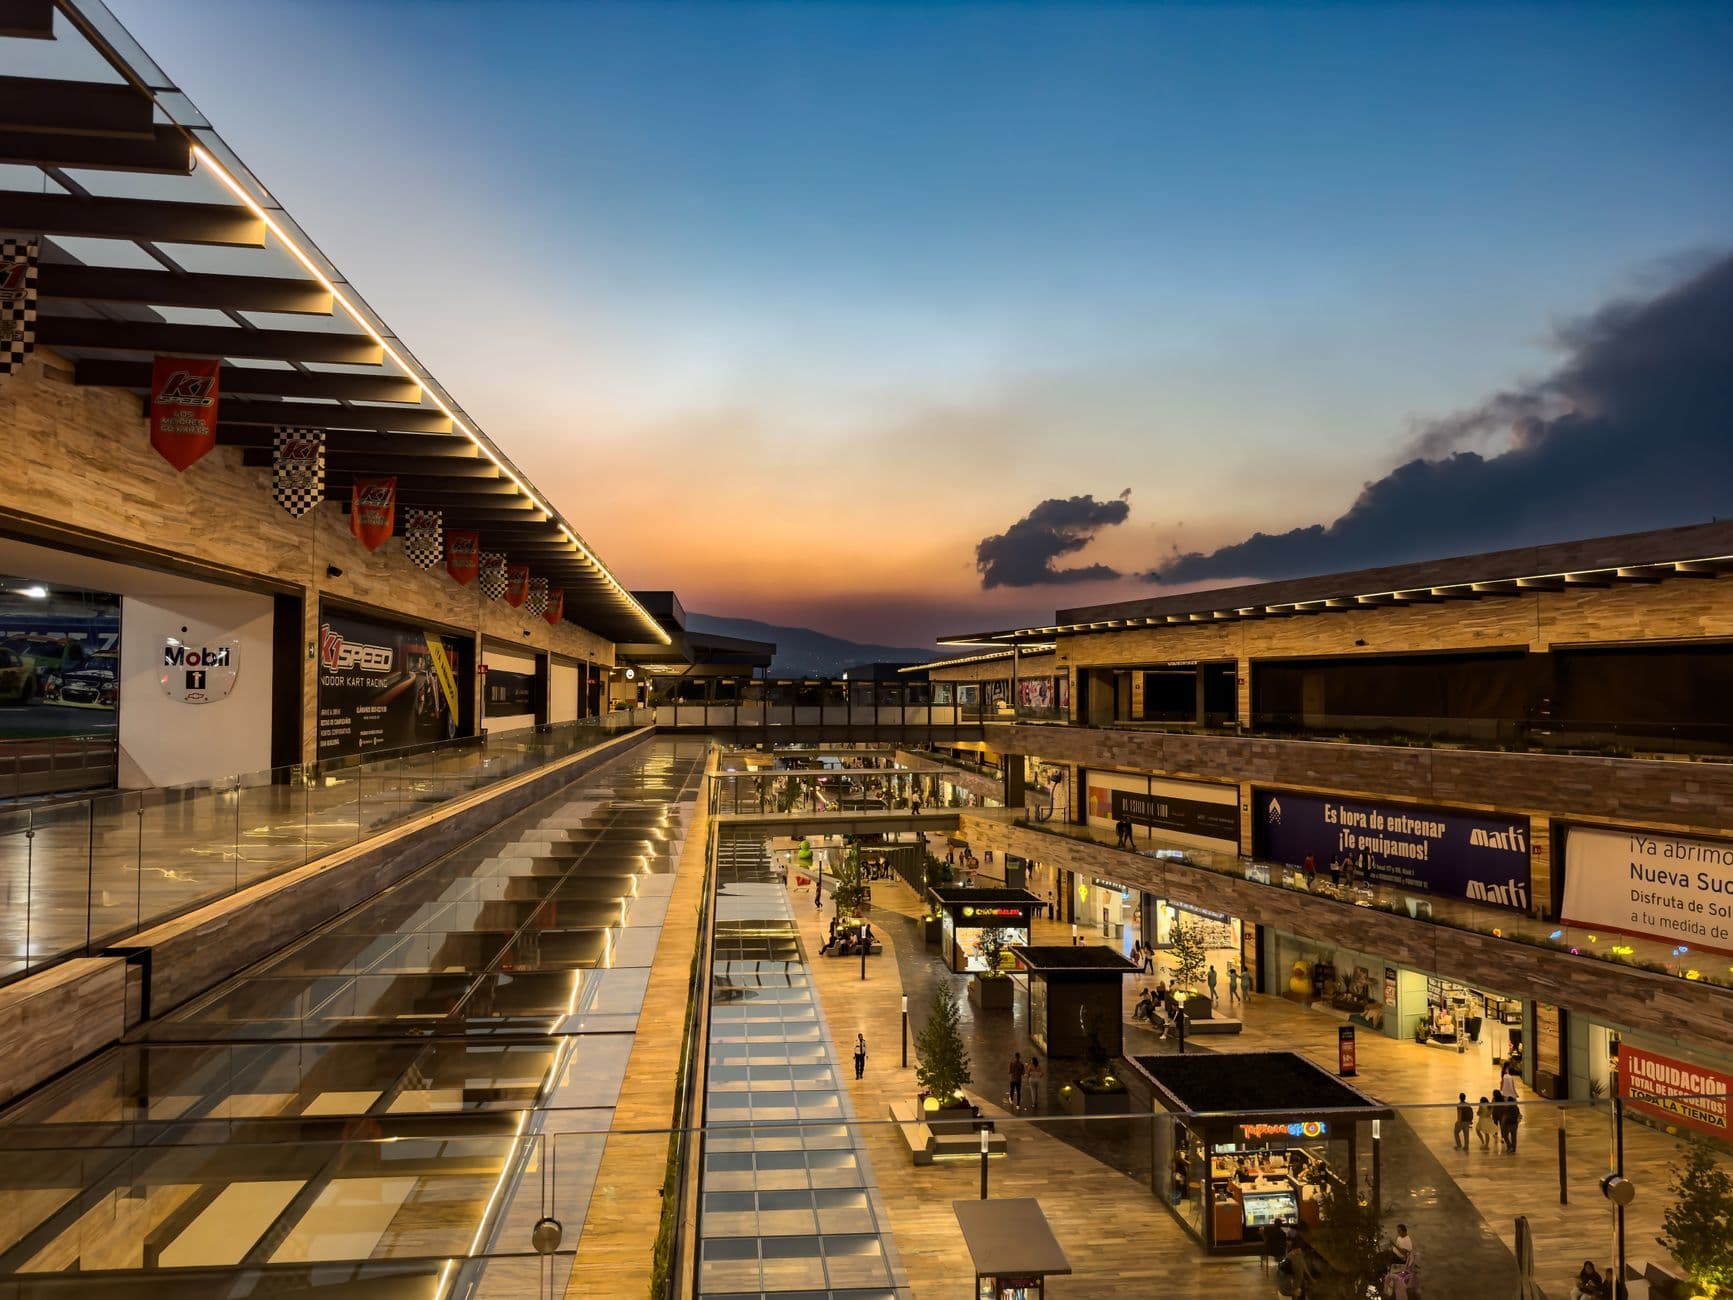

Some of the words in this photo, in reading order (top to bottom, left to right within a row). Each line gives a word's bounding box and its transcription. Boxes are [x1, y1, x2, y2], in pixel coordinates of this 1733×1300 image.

[161, 370, 215, 397] K1
[165, 647, 230, 667] Mobil
[320, 675, 345, 687] NDOOR
[346, 676, 365, 687] KART
[1324, 803, 1337, 824] Es
[1340, 806, 1367, 829] hora
[1370, 809, 1384, 831] de
[1387, 815, 1446, 839] entrenar
[1340, 828, 1356, 852] ¡Te
[1358, 833, 1429, 861] equipamos!
[1470, 826, 1526, 853] martí
[1630, 836, 1657, 856] ¡Ya
[1630, 862, 1690, 889] Nueva
[1466, 879, 1527, 910] martí
[1631, 889, 1684, 910] Disfruta
[1688, 900, 1704, 914] de
[1631, 911, 1638, 922] a
[1642, 911, 1656, 926] tu
[1660, 916, 1707, 936] medida
[1711, 926, 1729, 940] de
[1629, 1056, 1727, 1100] ¡LIQUIDACIÓN
[1631, 1075, 1655, 1092] TOTAL
[1656, 1083, 1667, 1098] DE
[1662, 1099, 1678, 1112] LA
[1681, 1105, 1726, 1128] TIENDA
